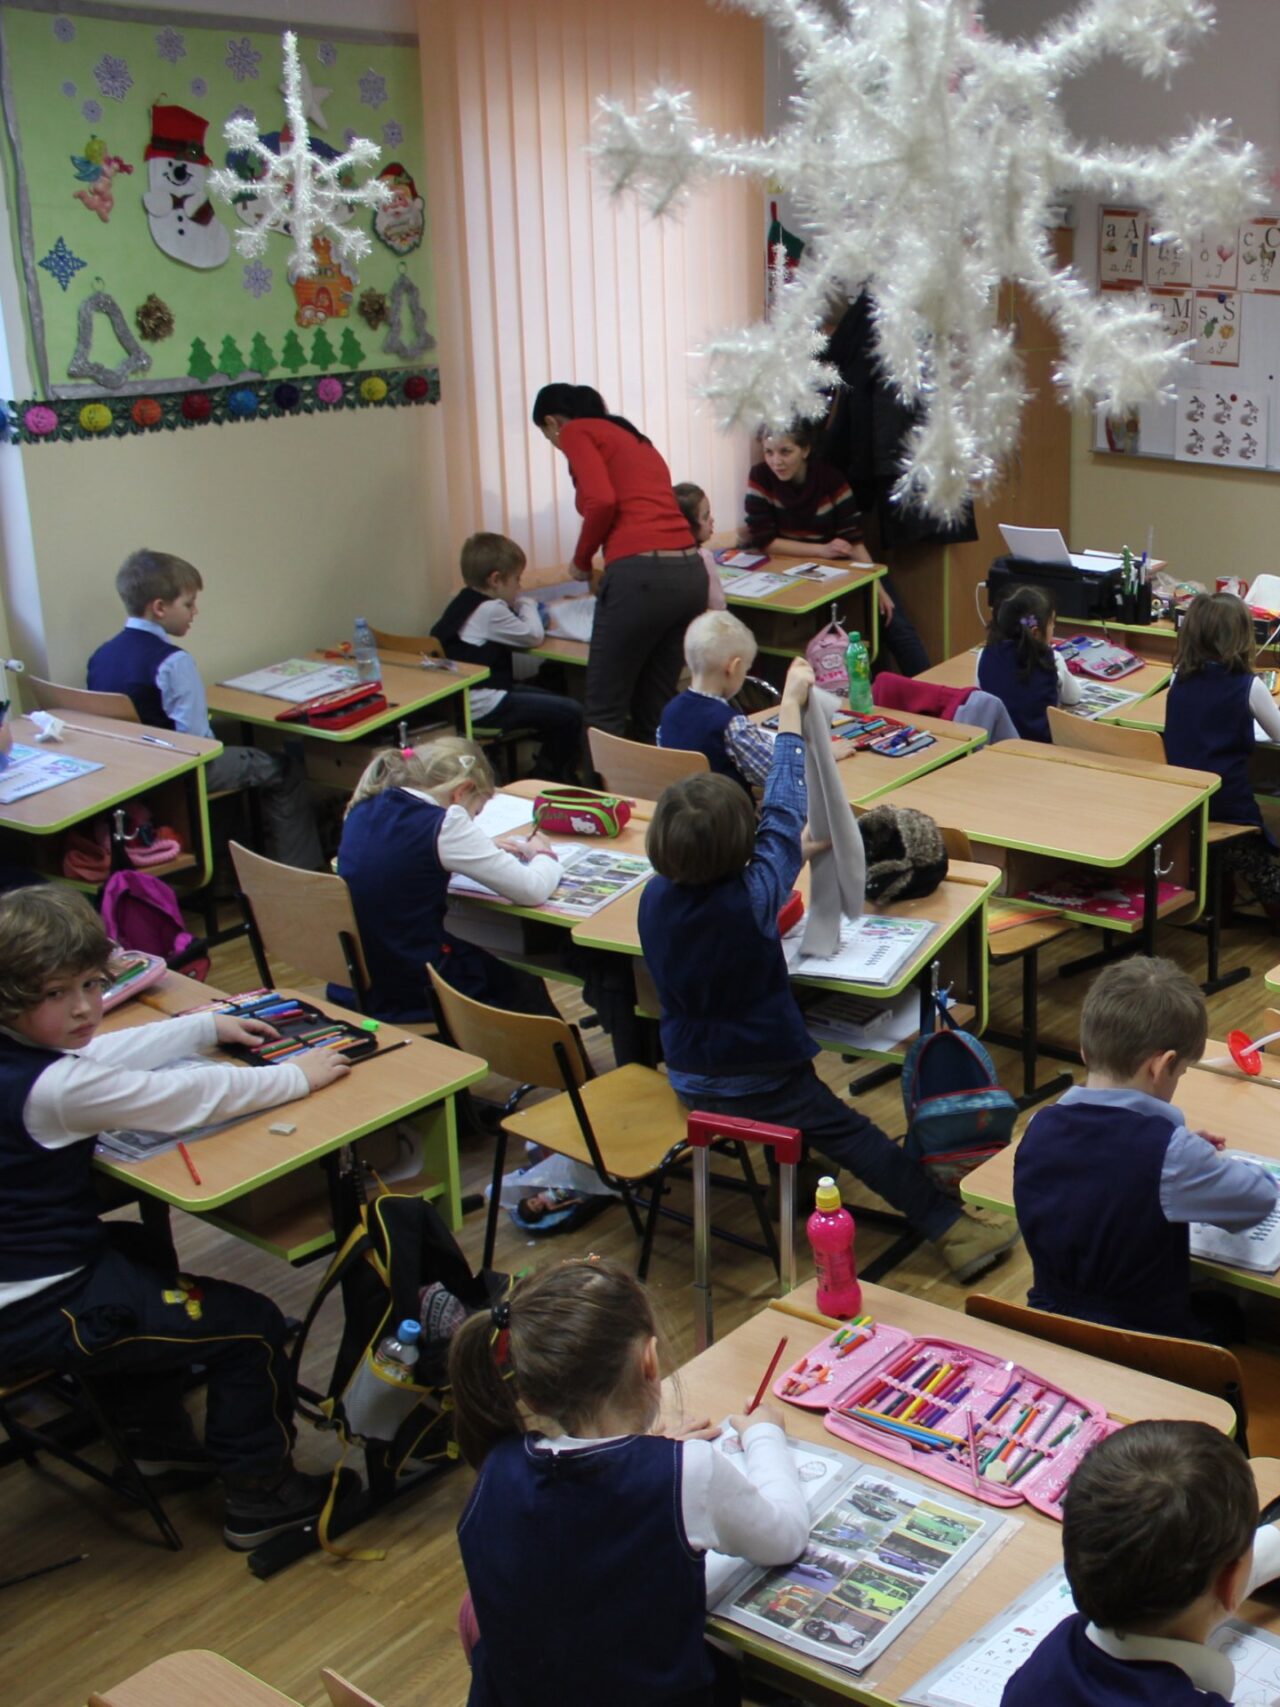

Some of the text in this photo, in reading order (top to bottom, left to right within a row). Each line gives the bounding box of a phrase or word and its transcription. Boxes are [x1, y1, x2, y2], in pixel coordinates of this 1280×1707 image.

[1106, 219, 1140, 239] a A
[1243, 227, 1280, 248] c C
[1170, 298, 1191, 319] M
[1199, 301, 1236, 322] s S
